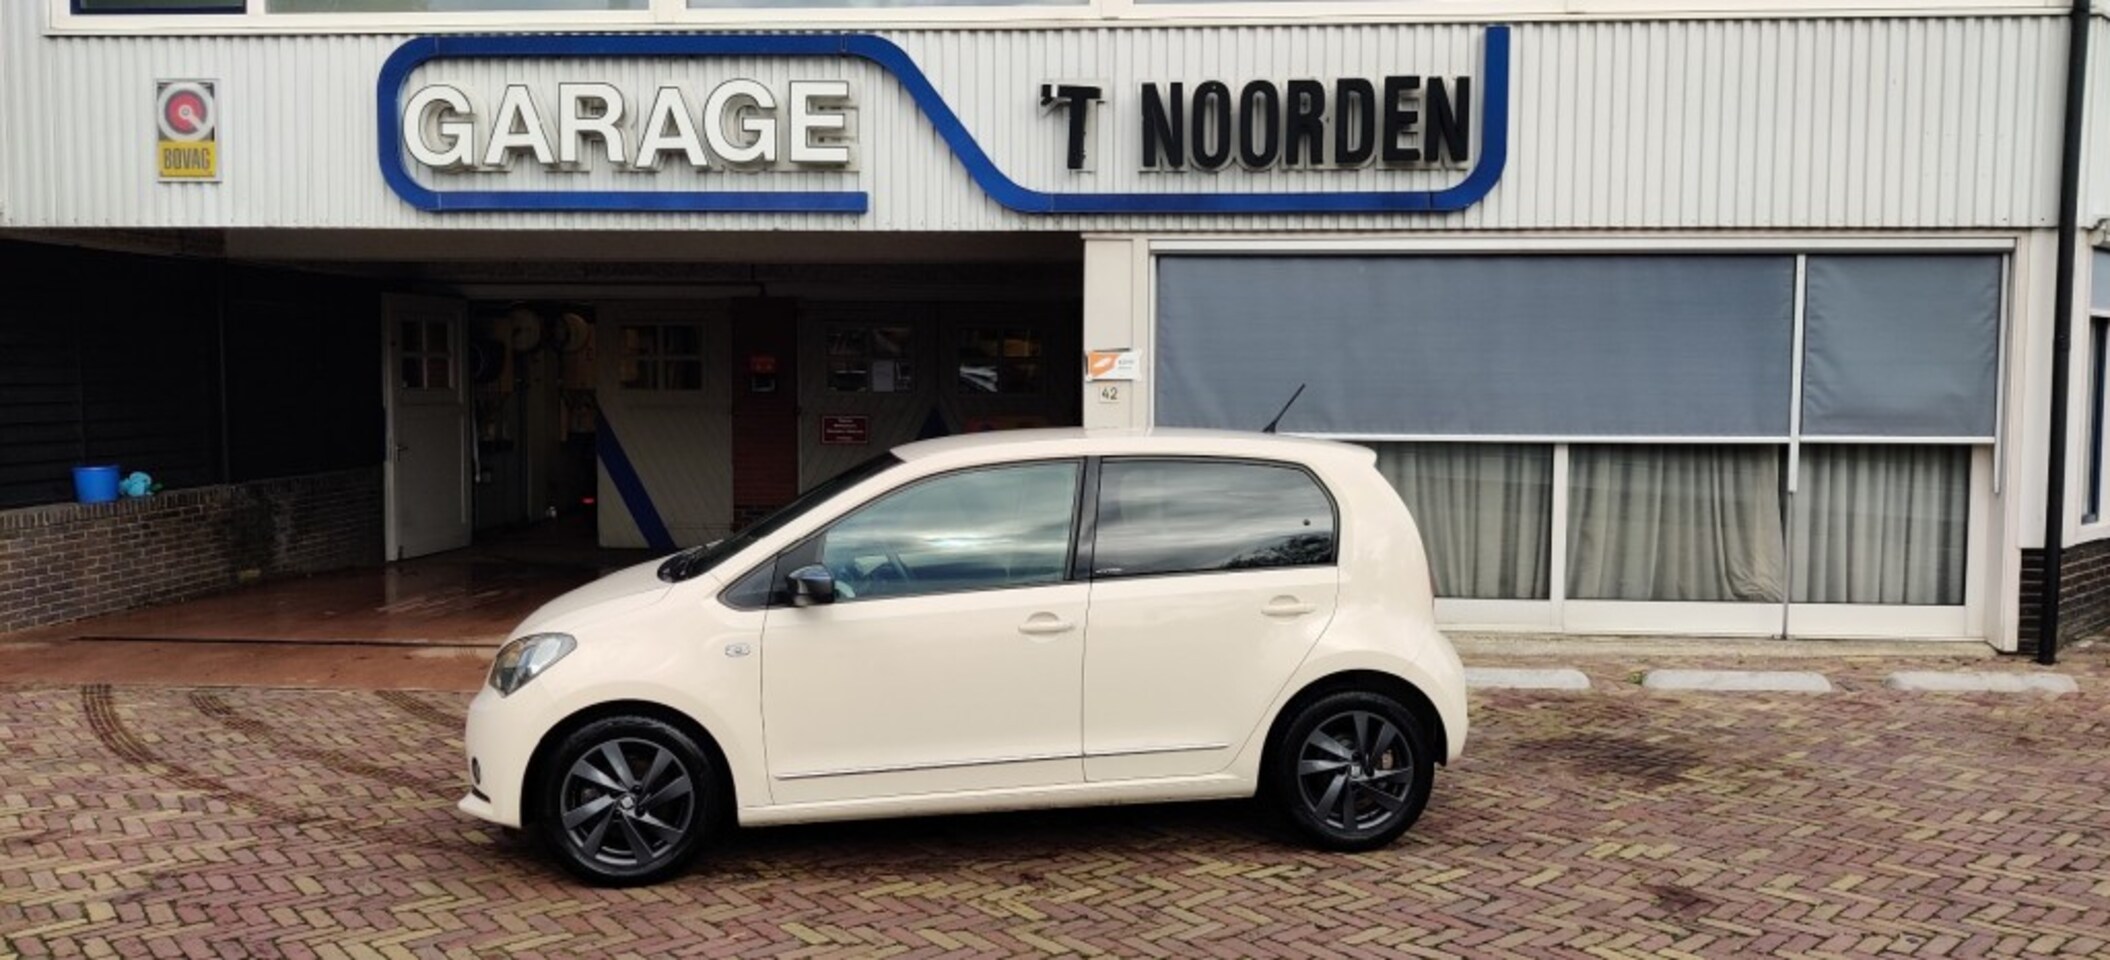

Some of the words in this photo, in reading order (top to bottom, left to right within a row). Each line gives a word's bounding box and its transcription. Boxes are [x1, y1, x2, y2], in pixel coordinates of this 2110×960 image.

[402, 77, 850, 169] GARAGE
[1040, 83, 1102, 170] 'T
[1140, 75, 1470, 169] NOORDEN
[163, 147, 211, 169] BOVAG
[1101, 386, 1118, 400] 42
